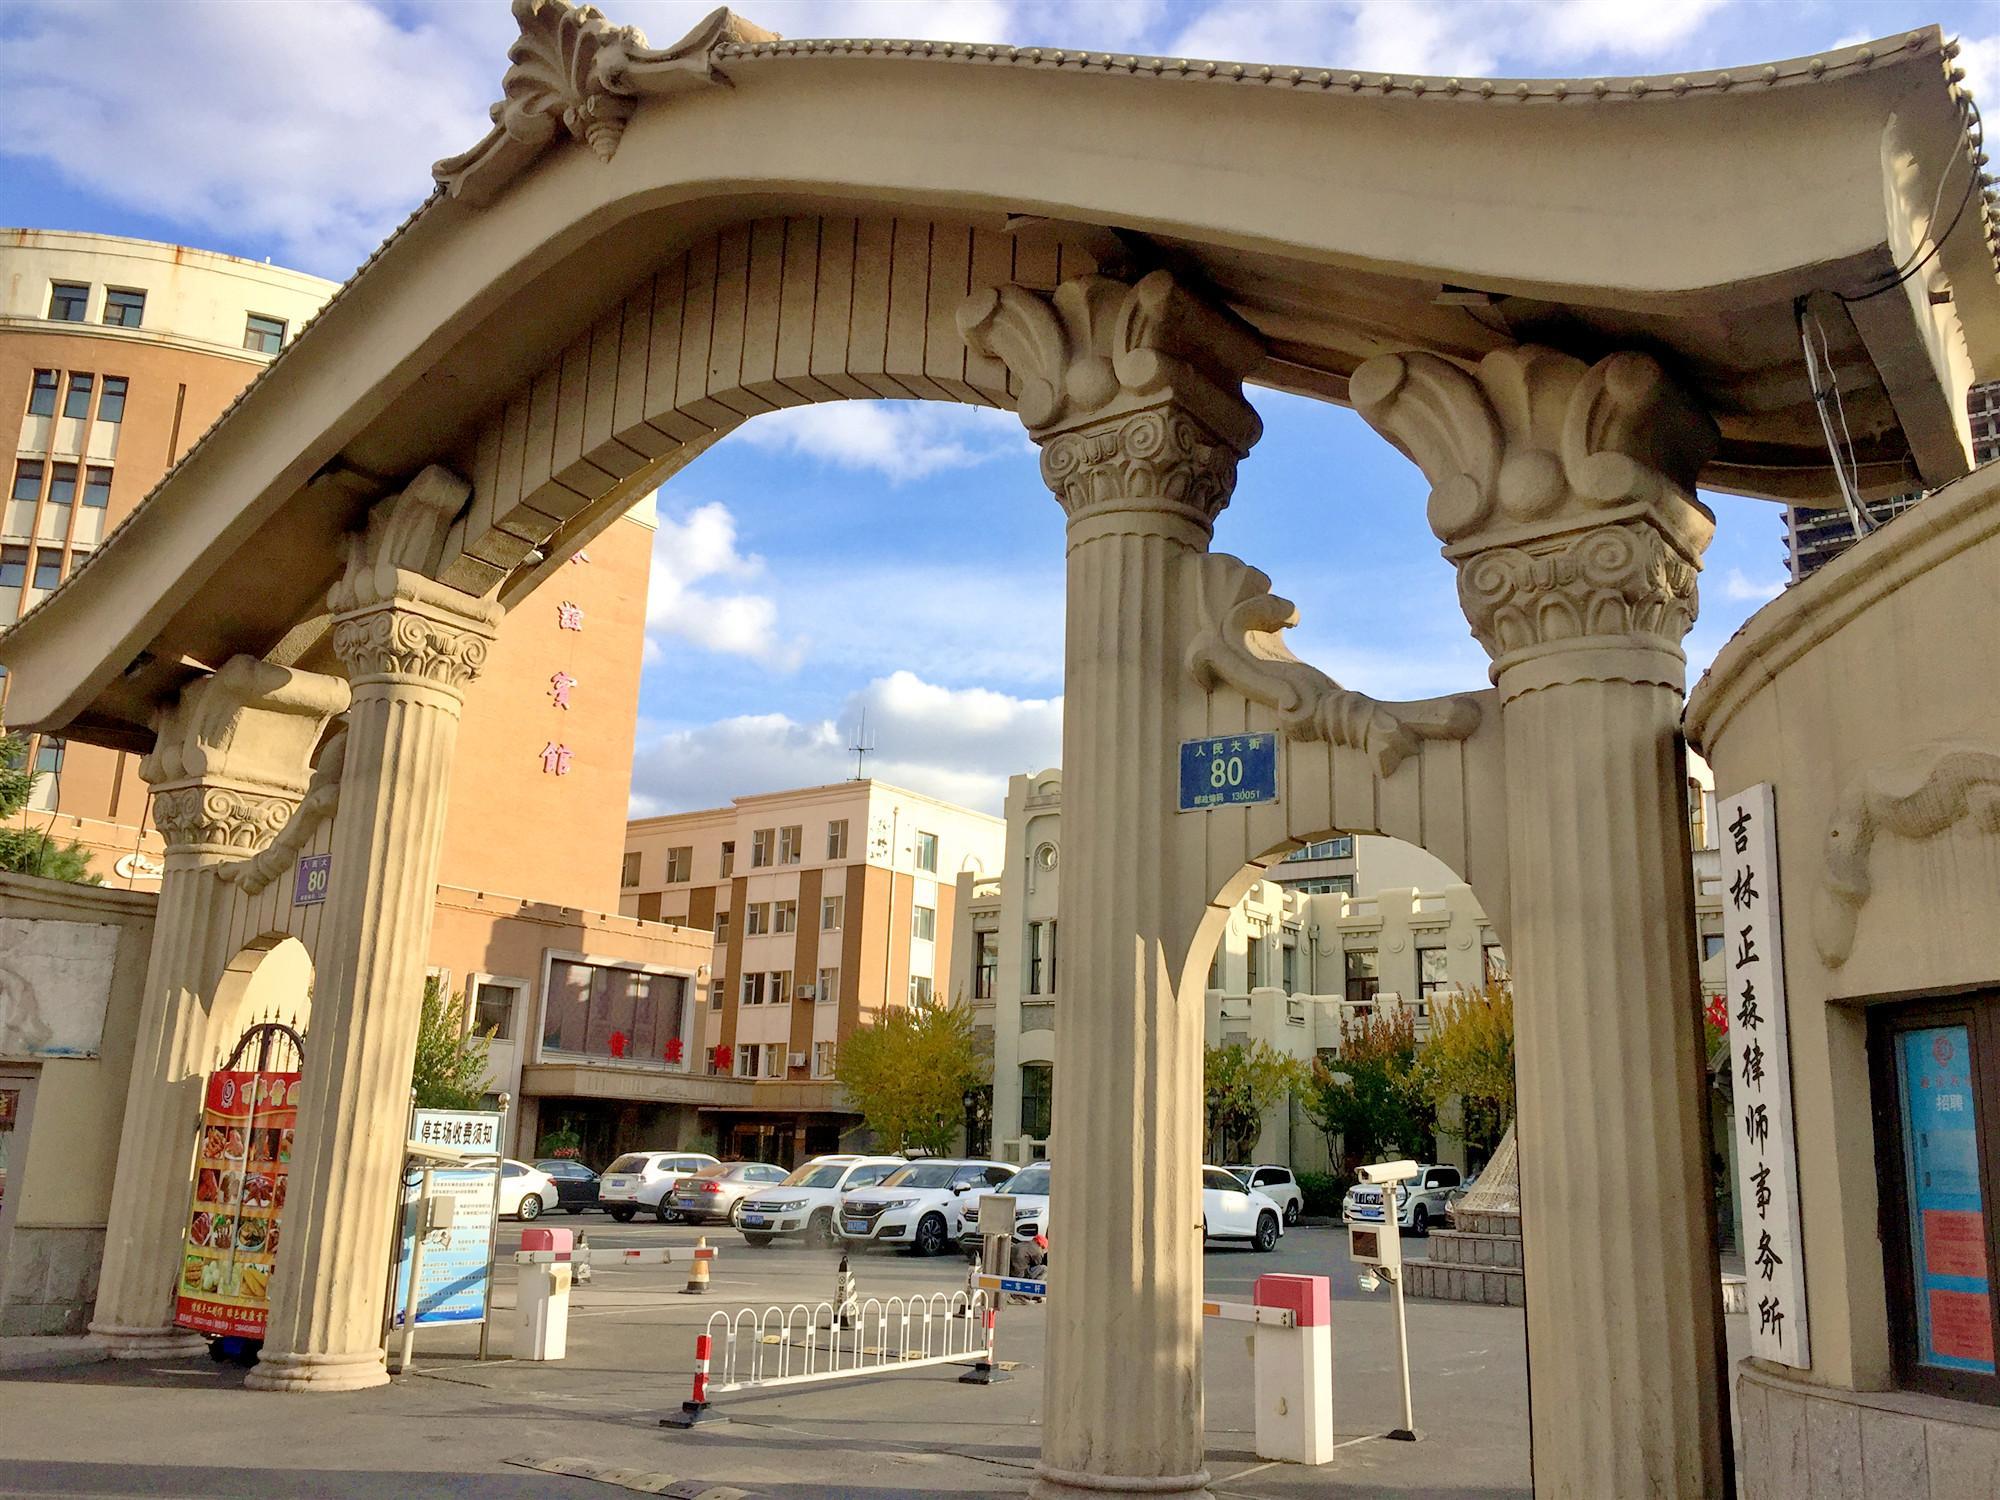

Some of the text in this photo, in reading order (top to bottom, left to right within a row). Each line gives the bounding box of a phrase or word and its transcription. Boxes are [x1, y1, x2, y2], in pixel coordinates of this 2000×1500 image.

[1195, 738, 1263, 757] 人民大街
[1211, 757, 1243, 787] 80
[1231, 790, 1260, 801] 130051
[308, 870, 326, 892] 80
[1728, 806, 1785, 1349] 吉林正森律师事务所
[1936, 1094, 1963, 1112] 招聘
[422, 1120, 493, 1145] 停车场收费须知
